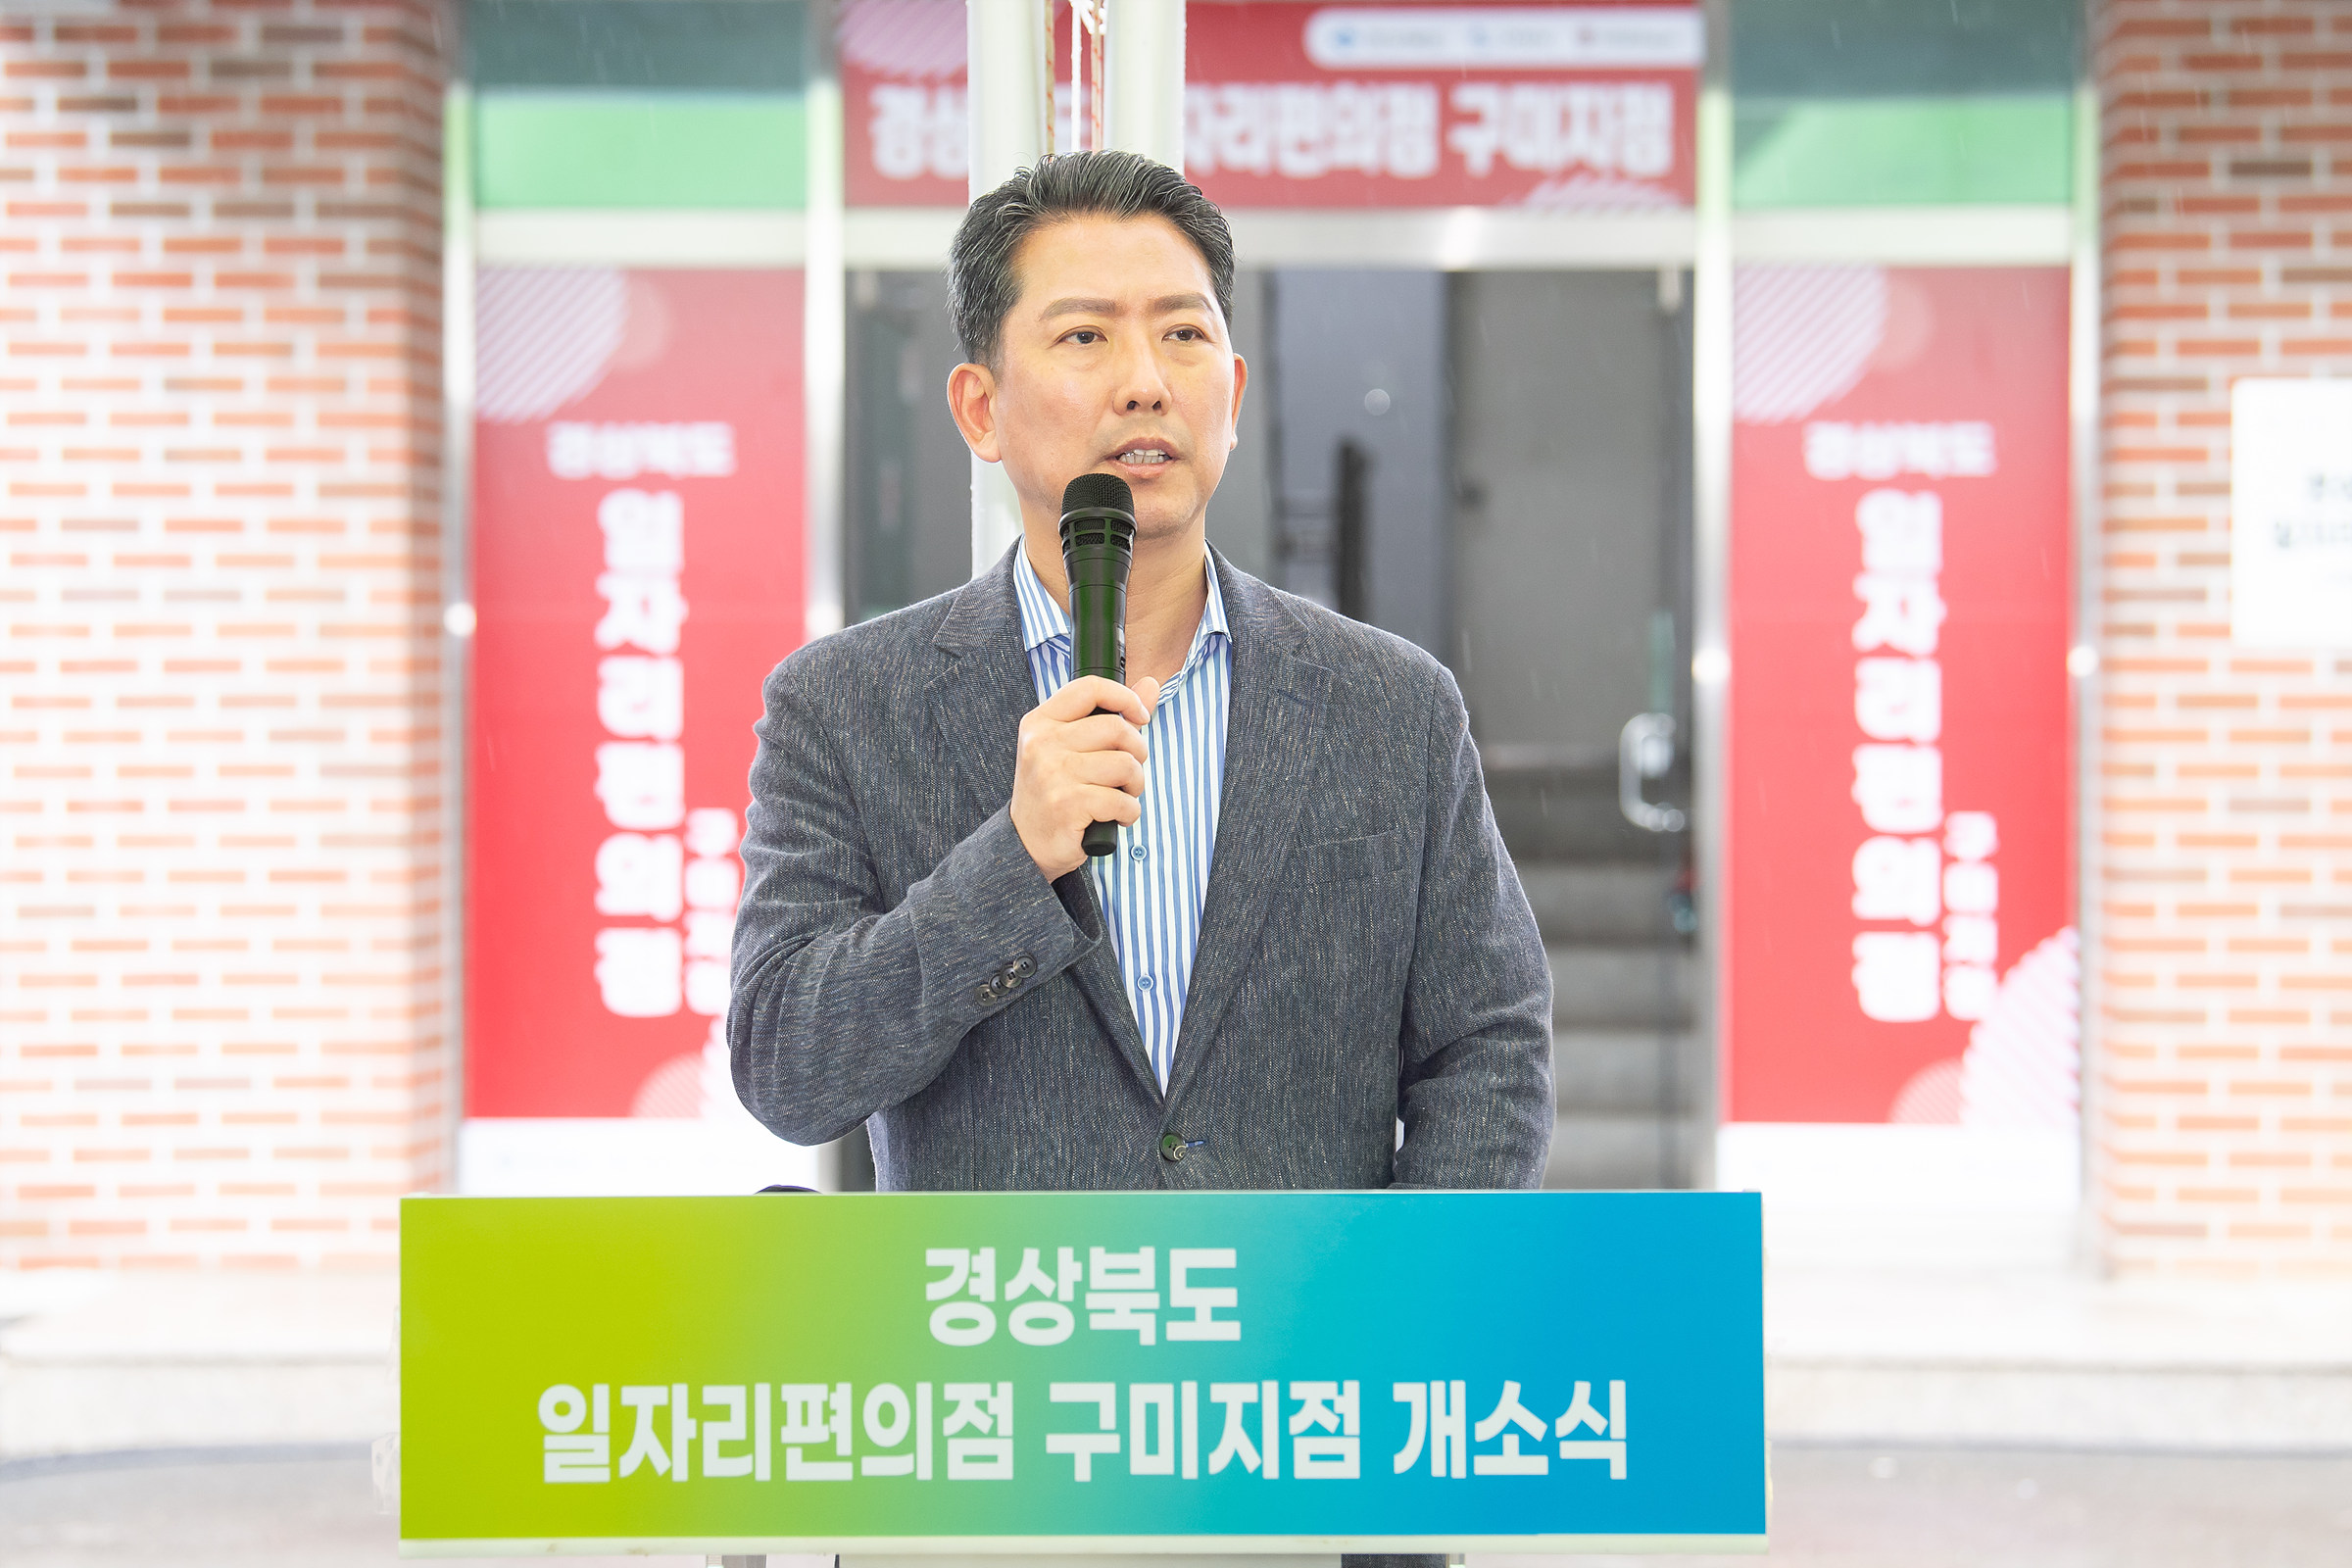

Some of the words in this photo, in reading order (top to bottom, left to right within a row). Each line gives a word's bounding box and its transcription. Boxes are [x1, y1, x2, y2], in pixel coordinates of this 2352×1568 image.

[924, 1246, 1243, 1348] 경상북도
[538, 1380, 1015, 1484] 일자리편의점
[1045, 1380, 1361, 1483] 구미지점
[1393, 1380, 1628, 1480] 개소식
